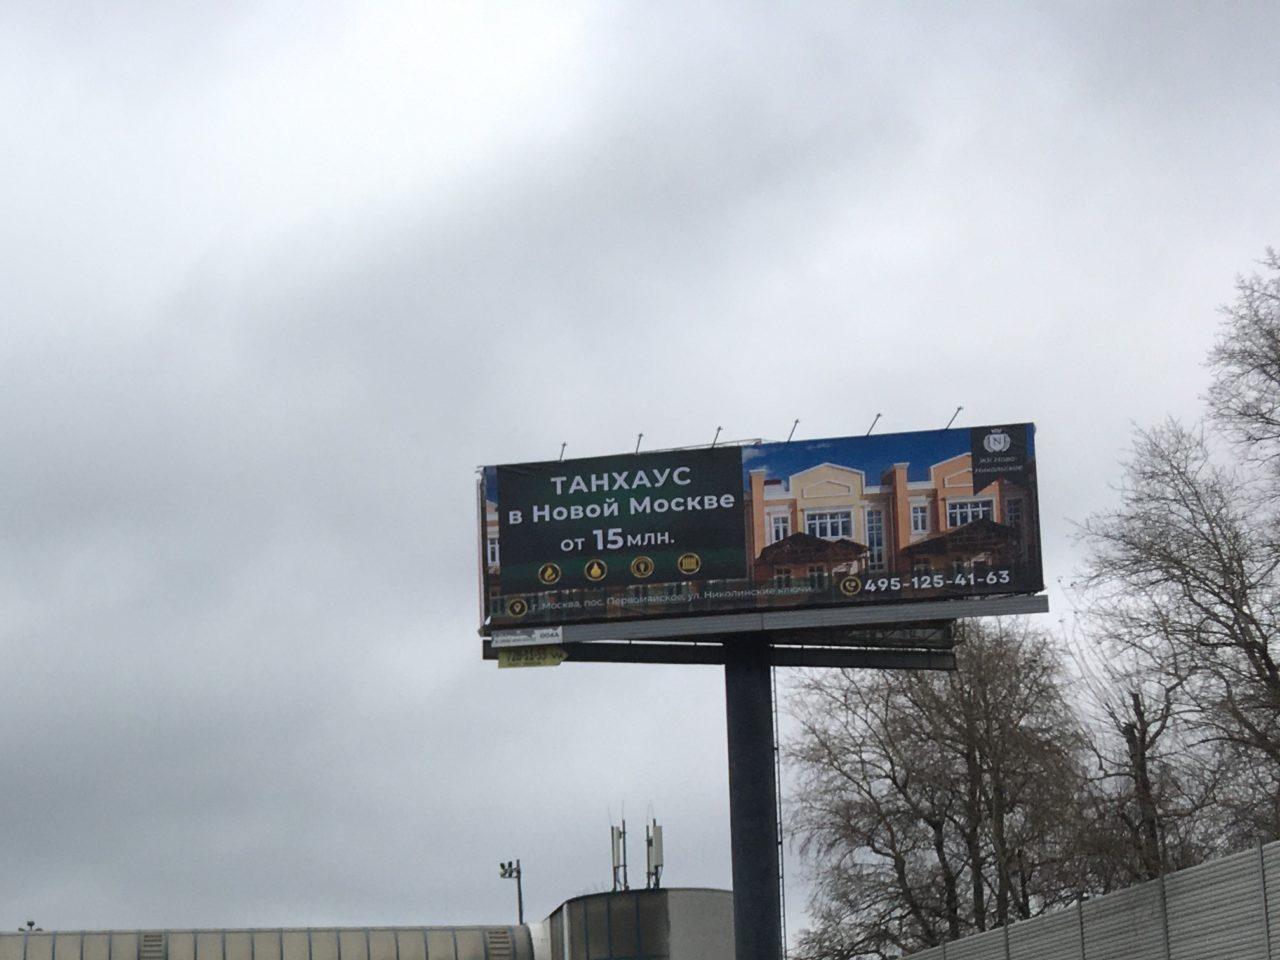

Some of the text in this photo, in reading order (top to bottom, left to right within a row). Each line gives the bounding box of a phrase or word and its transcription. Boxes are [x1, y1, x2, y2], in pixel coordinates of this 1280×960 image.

[550, 466, 692, 496] ТАНХАУС
[508, 493, 735, 525] в Новой Москве
[560, 527, 675, 552] от 15 млн.
[864, 570, 1011, 592] 495-125-41-63
